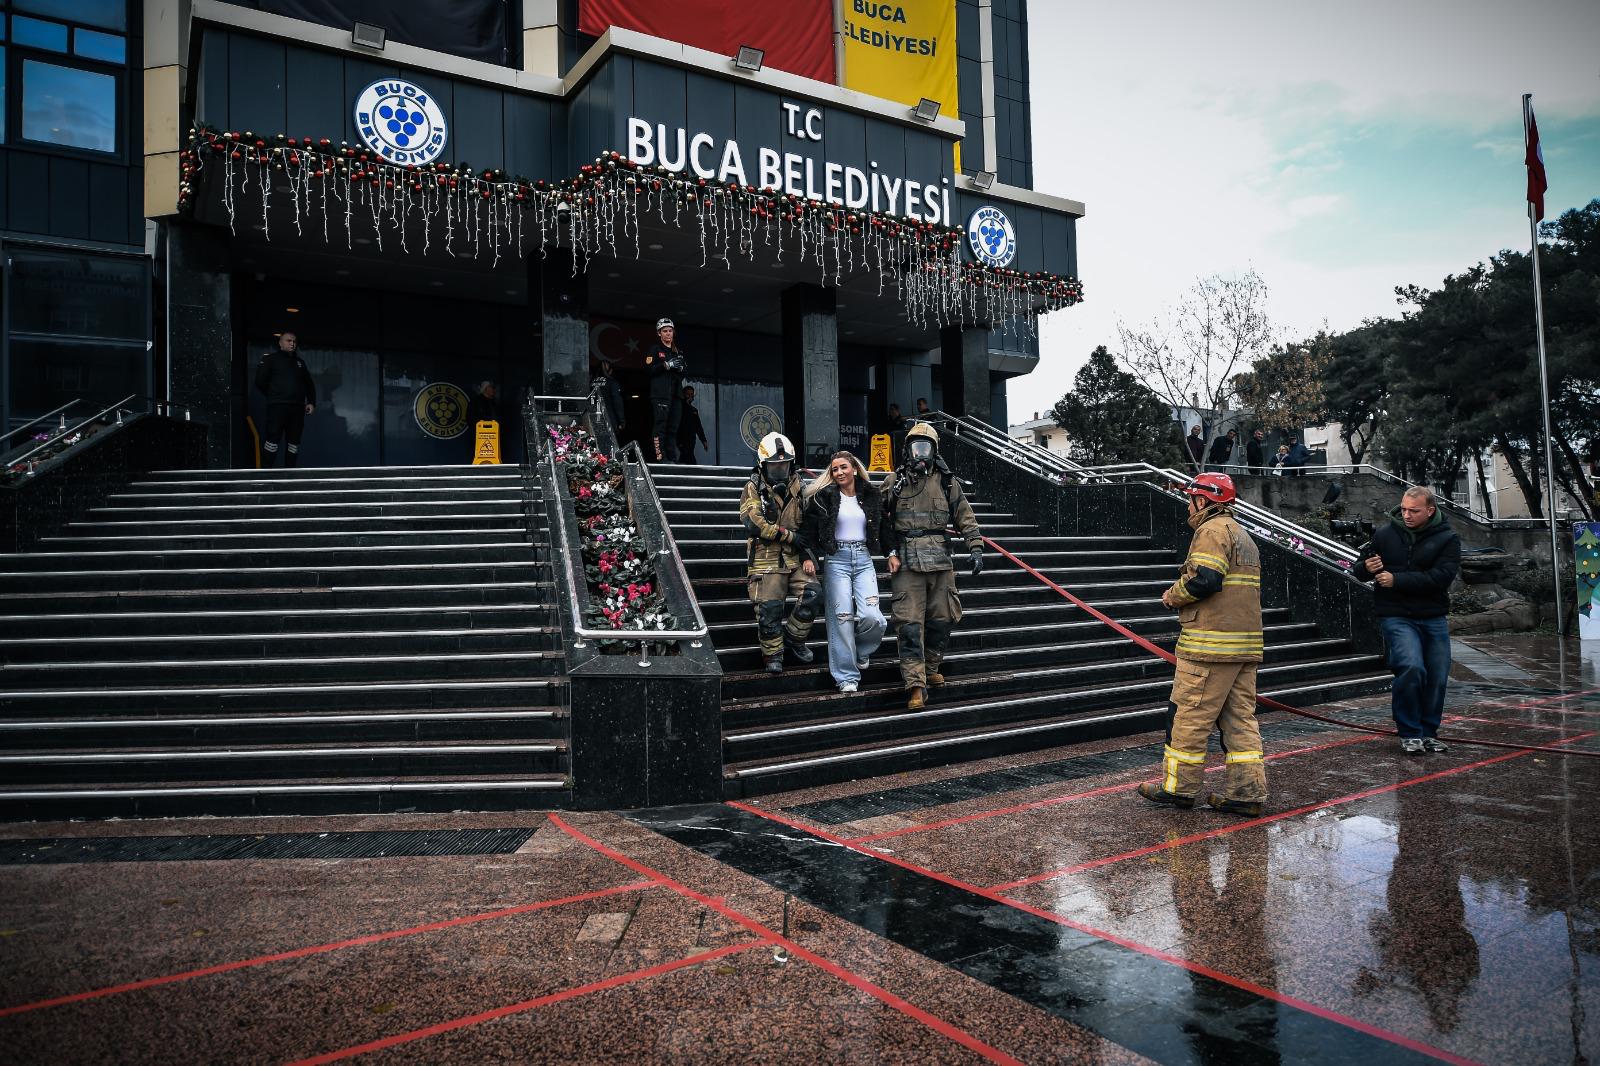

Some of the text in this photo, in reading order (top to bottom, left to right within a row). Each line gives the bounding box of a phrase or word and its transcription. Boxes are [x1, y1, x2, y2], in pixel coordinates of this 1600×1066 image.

[853, 0, 907, 23] BUCA
[374, 83, 428, 107] BUCA
[782, 102, 822, 140] T.C
[628, 117, 748, 184] BUCA
[759, 147, 950, 226] BELEDİYESİ
[978, 209, 1006, 225] BUCA
[840, 424, 869, 435] SONEL
